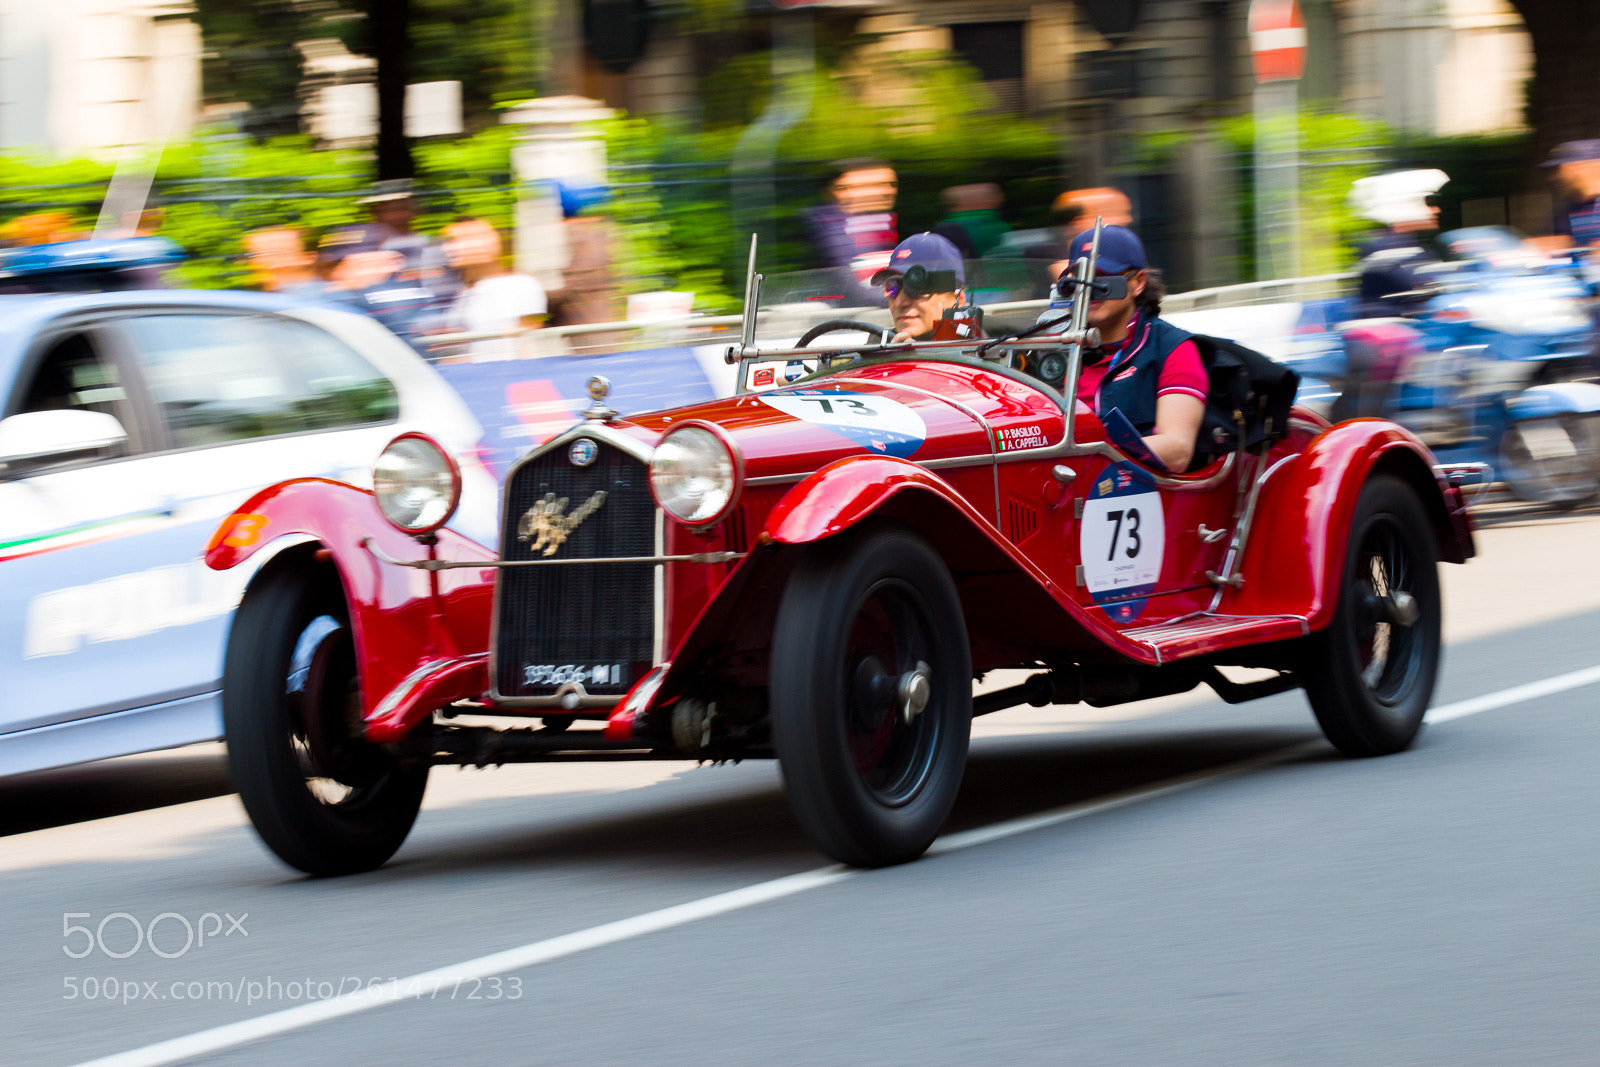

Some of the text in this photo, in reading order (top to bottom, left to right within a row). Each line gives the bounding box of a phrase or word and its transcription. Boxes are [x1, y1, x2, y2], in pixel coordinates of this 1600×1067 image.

[800, 398, 878, 417] 73
[1007, 436, 1048, 450] A. CAPPELLA
[1106, 508, 1141, 561] 73
